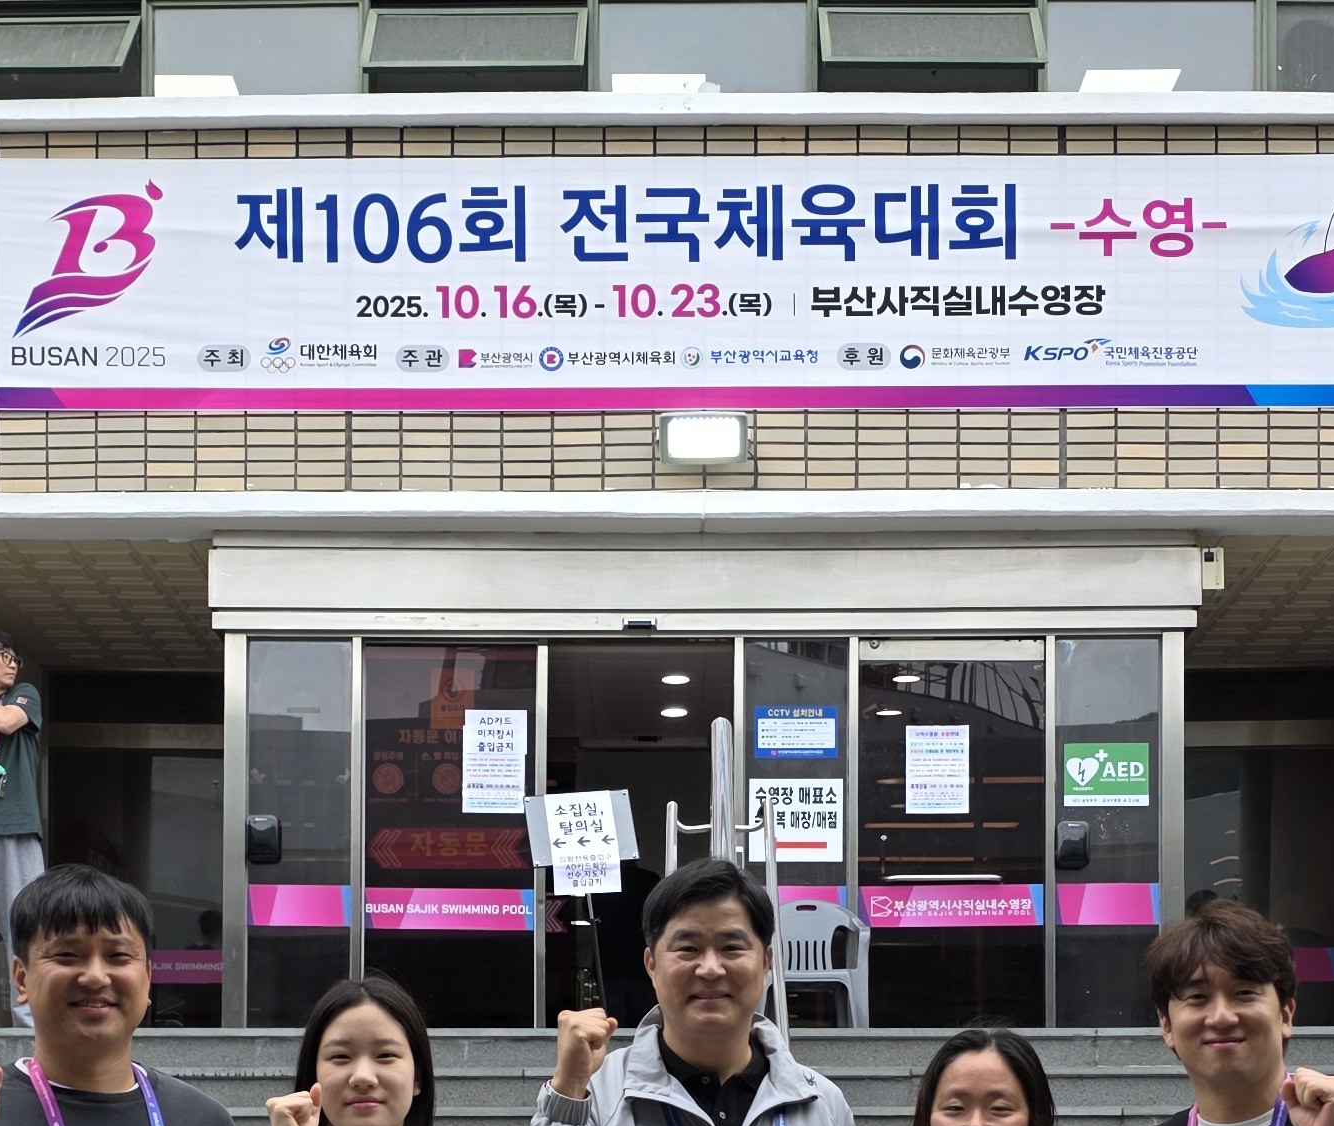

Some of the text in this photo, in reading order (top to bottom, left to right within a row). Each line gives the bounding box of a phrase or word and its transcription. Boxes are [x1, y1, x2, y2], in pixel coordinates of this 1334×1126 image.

[234, 185, 526, 264] 제106회
[560, 183, 1016, 263] 전국체육대회
[356, 295, 428, 318] 2025.
[811, 284, 1106, 317] 부산사직실내수영장
[11, 346, 166, 367] BUSAN 2025
[300, 343, 377, 360] 대한체육회
[480, 351, 533, 364] 부산광역시
[567, 351, 676, 366] 부산광역시체육회
[710, 349, 818, 364] 부산광역시교육청
[931, 347, 1011, 359] 문화체육관광부
[1024, 345, 1089, 361] KSPO
[1103, 346, 1198, 360] 국민체육진흥공단
[767, 708, 823, 717] CCTV 설치안내
[479, 717, 512, 725] AD카드
[399, 729, 440, 744] 자동문
[477, 729, 514, 740] 미지참시
[477, 742, 514, 752] 출입금지
[1102, 761, 1144, 778] AED
[755, 786, 837, 805] 수영장 매표소
[559, 819, 603, 836] 탈의실
[790, 811, 837, 830] 매장/매점
[410, 831, 488, 857] 자동문
[365, 903, 533, 915] BUSAN SAJIK SWIMMING POOL
[893, 898, 1032, 912] 부산광역시사직실내수영장
[151, 962, 173, 972] AJIK
